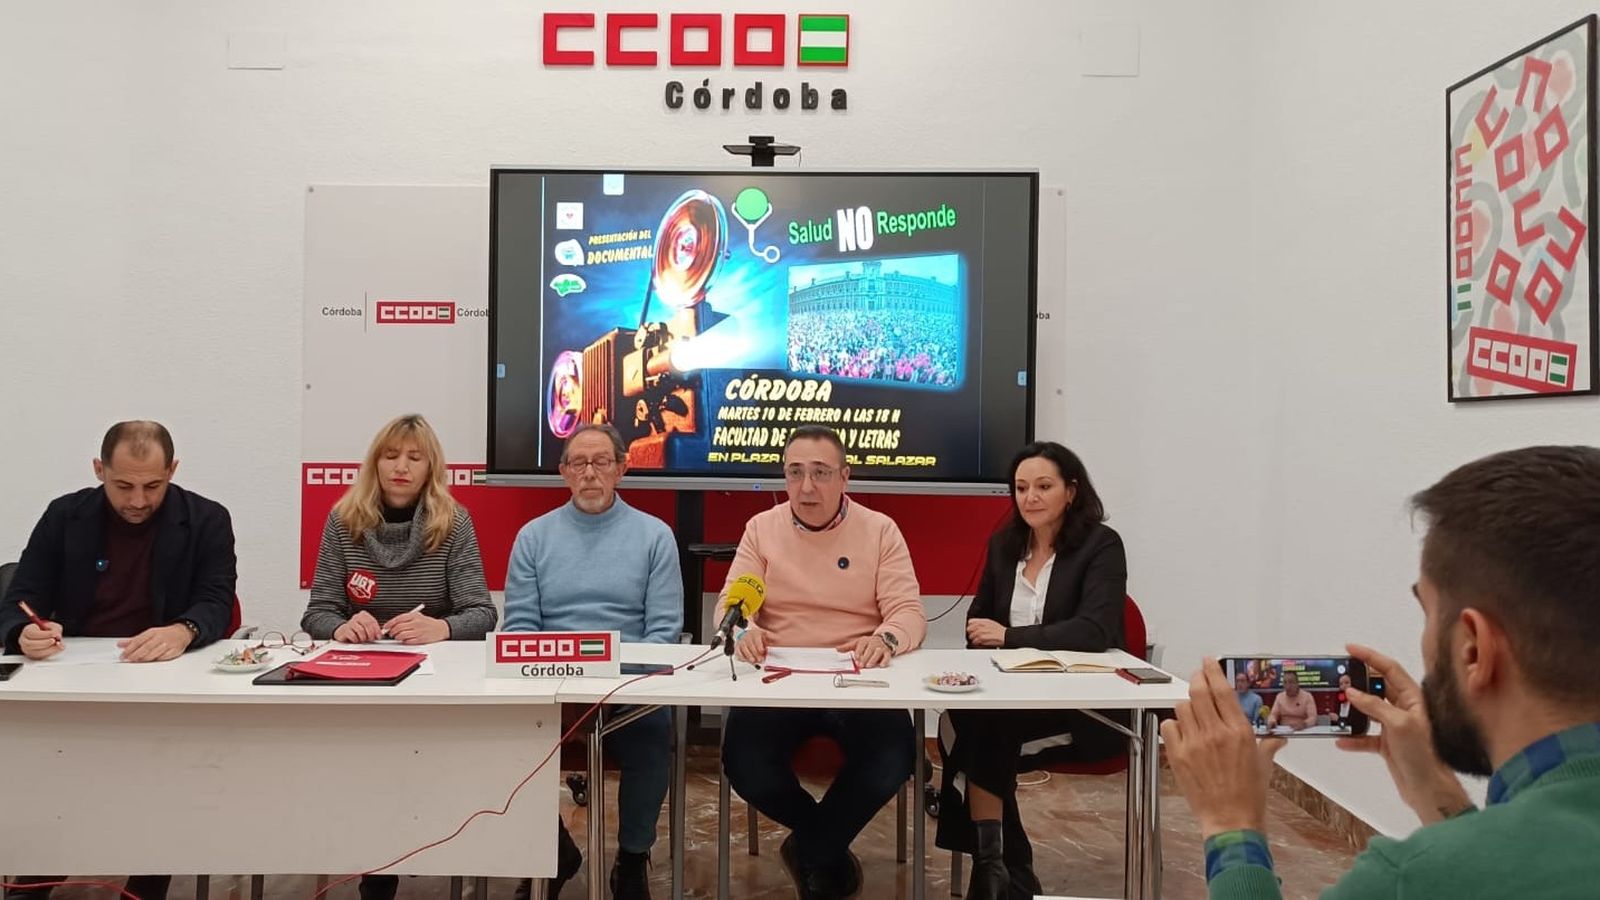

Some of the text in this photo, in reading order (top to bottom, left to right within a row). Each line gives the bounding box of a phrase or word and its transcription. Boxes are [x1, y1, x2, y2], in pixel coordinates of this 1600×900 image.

[543, 13, 786, 66] CCOO
[665, 78, 848, 110] Córdoba
[588, 229, 652, 245] PRESENTACIÓN DEL
[788, 204, 956, 252] Salud NO Responde
[586, 245, 654, 265] DOCUMENTAL
[321, 306, 437, 320] Córdoba CCOO
[457, 307, 488, 317] Córdo
[1472, 337, 1548, 378] CCOO
[724, 374, 833, 402] CÓRDOBA
[717, 406, 901, 423] MARTES 10 DE FEBRERO A LAS 18 H
[712, 427, 769, 446] FACULTAD
[770, 428, 787, 447] DE
[848, 430, 858, 448] Y
[859, 429, 901, 449] LETRAS
[707, 453, 729, 462] EN
[730, 453, 780, 463] PLAZA
[864, 455, 936, 466] SALAZAR
[306, 468, 359, 485] CCO
[350, 572, 376, 592] UGT
[501, 639, 575, 657] CCOO
[521, 664, 584, 677] Córdoba
